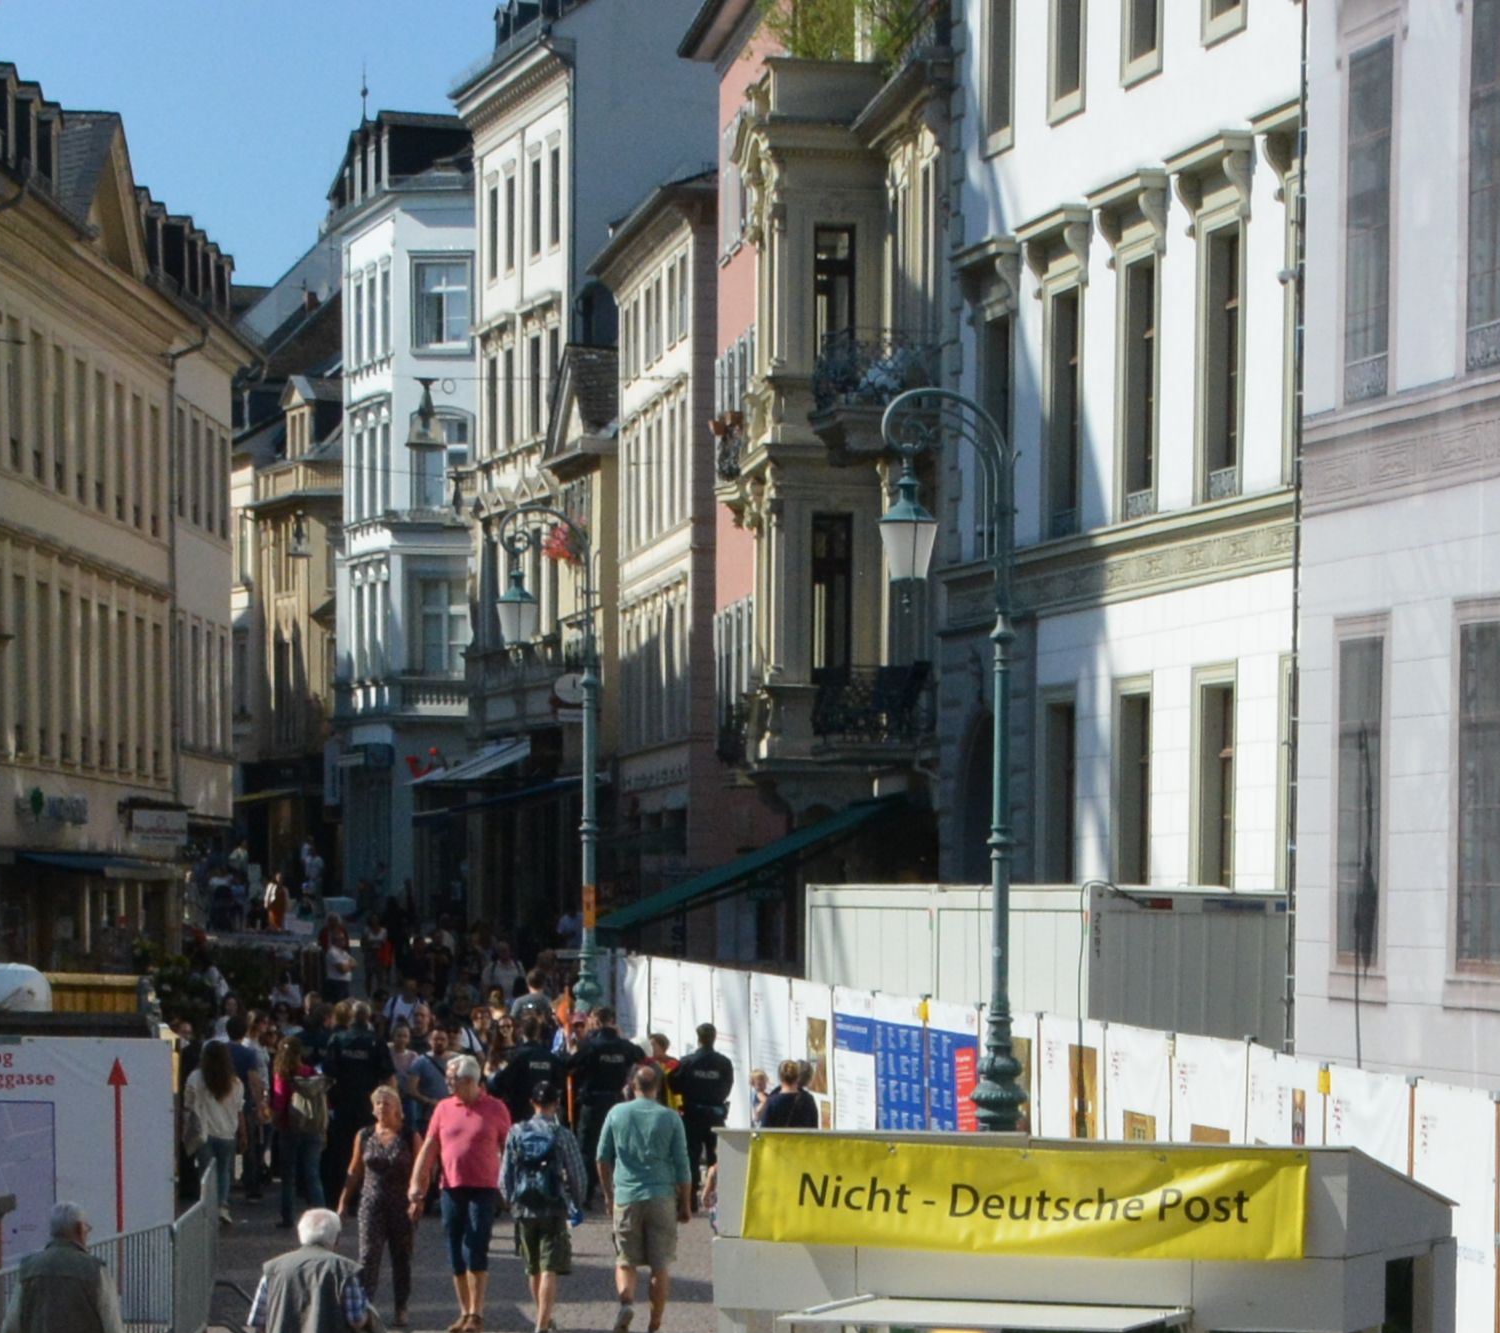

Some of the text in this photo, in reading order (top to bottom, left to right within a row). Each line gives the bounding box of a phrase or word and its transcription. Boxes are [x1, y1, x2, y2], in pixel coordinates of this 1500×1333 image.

[798, 1172, 910, 1215] Nicht
[949, 1183, 1145, 1225] Deutsche
[1158, 1187, 1249, 1225] Post
